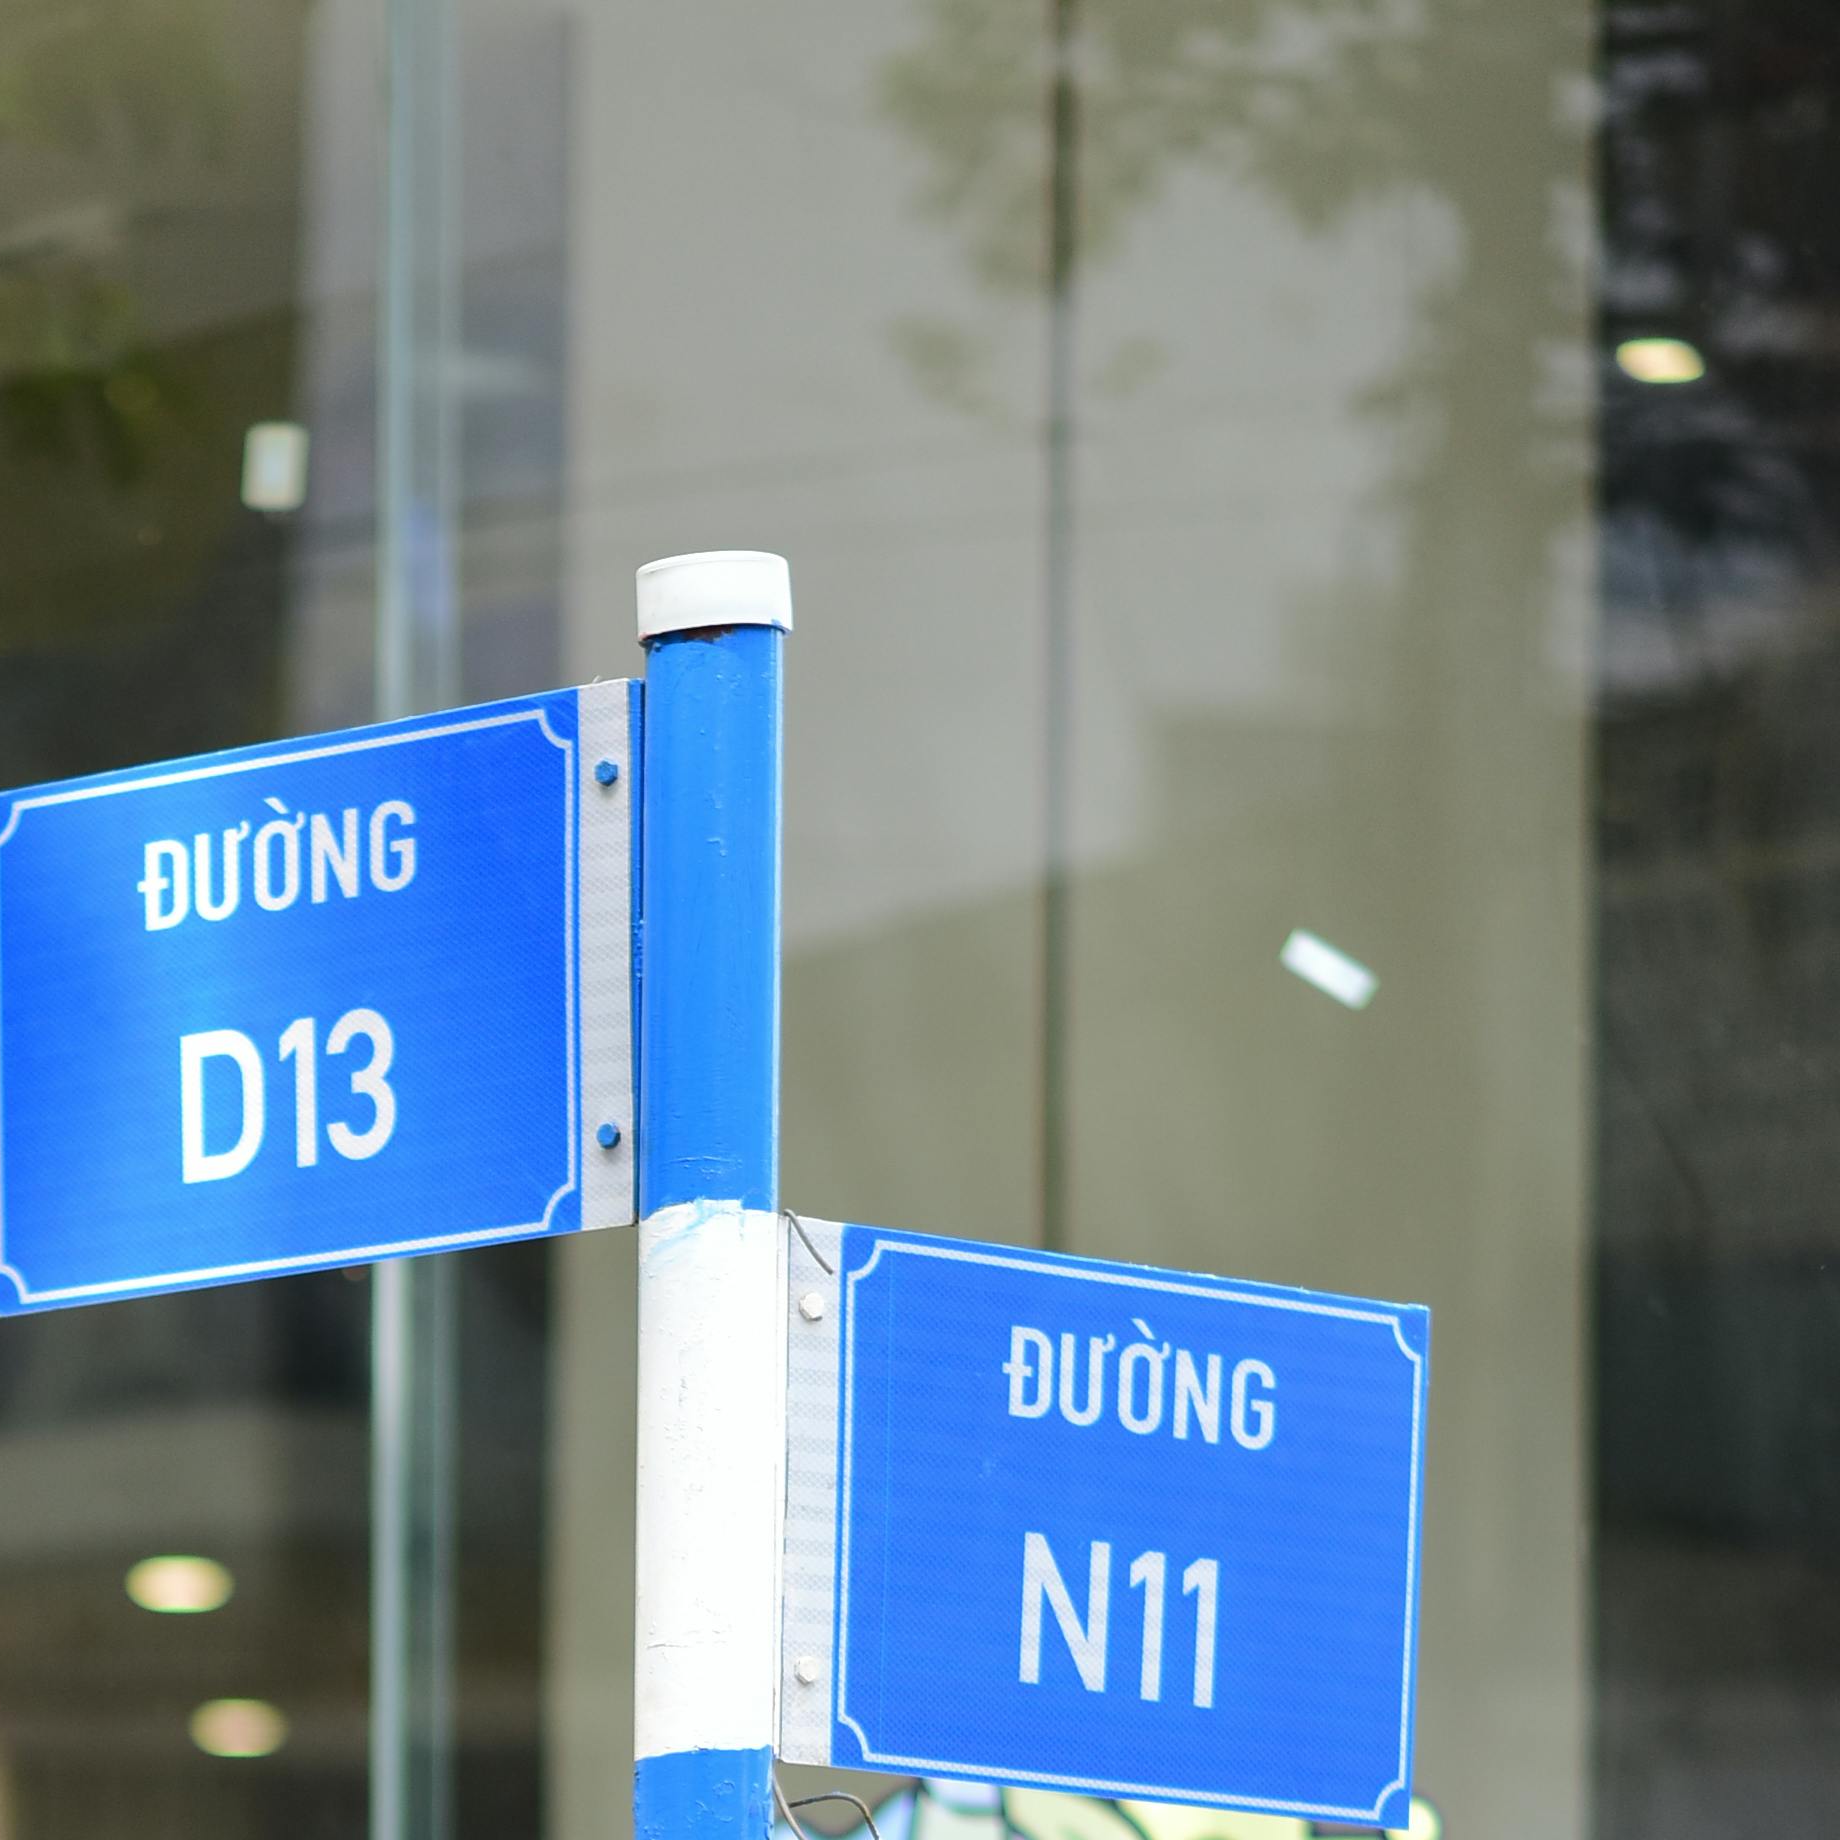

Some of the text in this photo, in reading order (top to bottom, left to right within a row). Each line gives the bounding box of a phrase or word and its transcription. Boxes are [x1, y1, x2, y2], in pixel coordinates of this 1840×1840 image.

[137, 796, 417, 932] ĐƯỜNG
[179, 1008, 397, 1184] D13
[1002, 1317, 1277, 1450] ĐƯỜNG
[1018, 1531, 1219, 1709] N11
